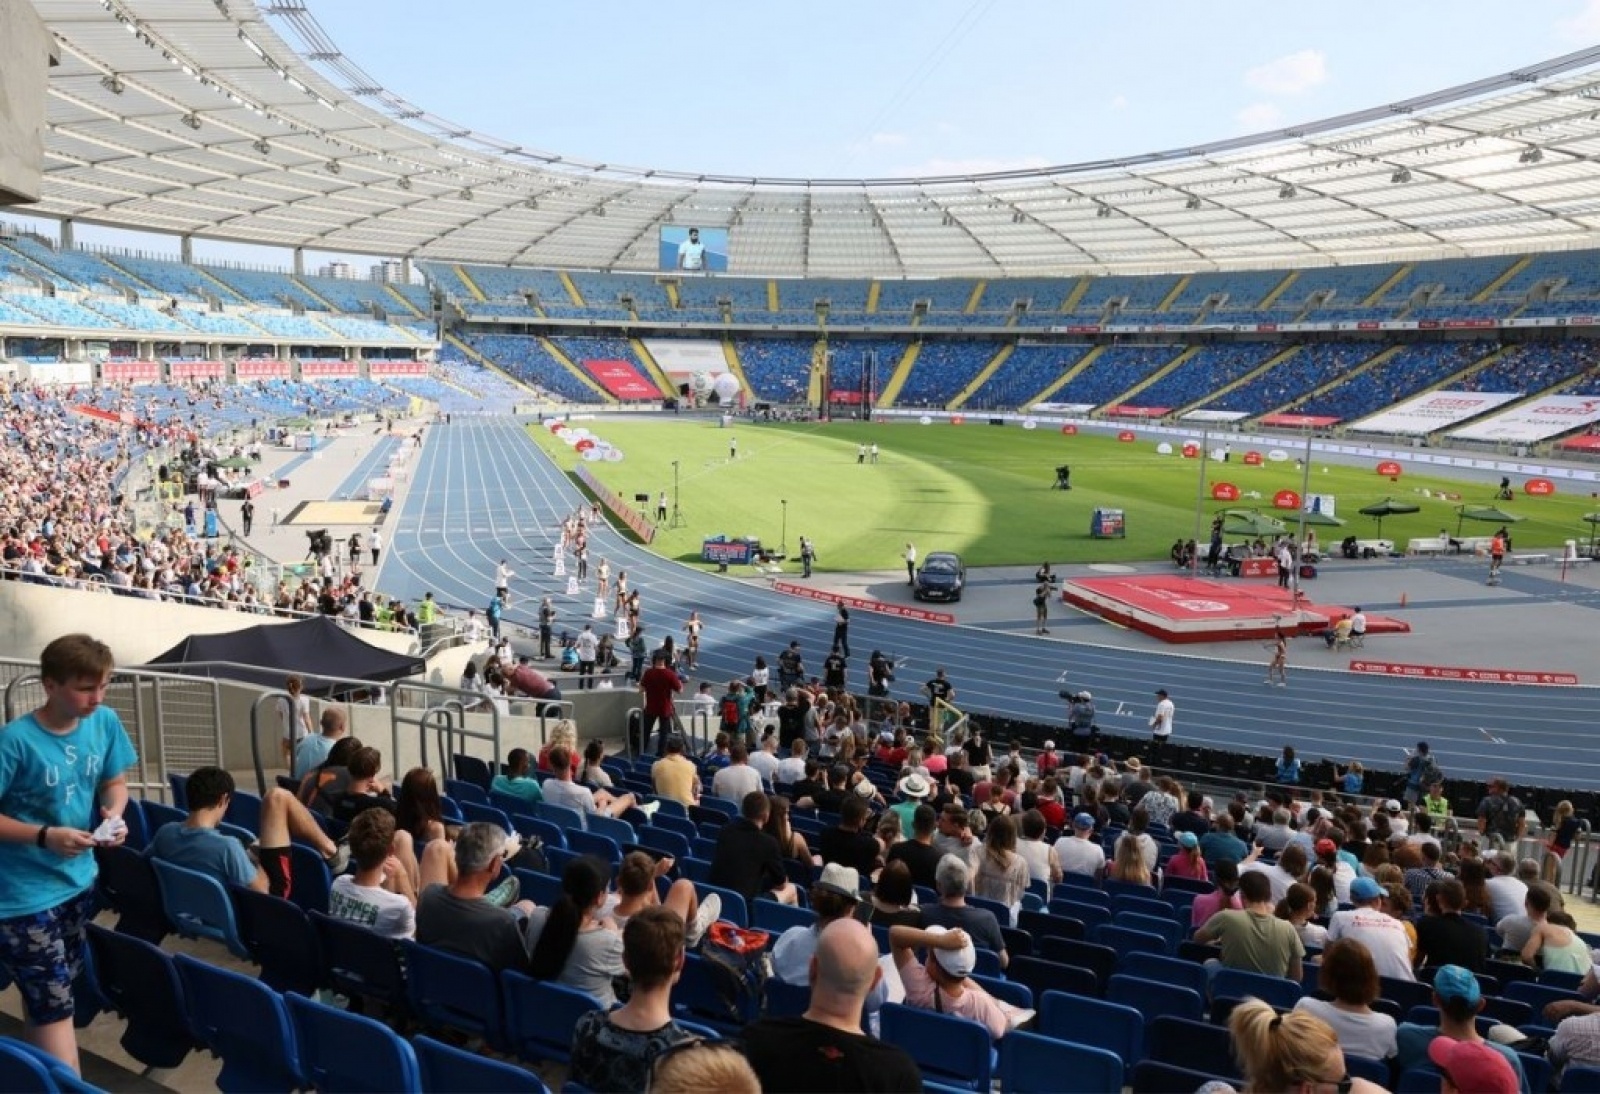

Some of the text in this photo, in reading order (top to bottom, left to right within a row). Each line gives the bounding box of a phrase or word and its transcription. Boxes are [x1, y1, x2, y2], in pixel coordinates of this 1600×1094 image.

[65, 745, 77, 765] S
[86, 754, 99, 776] R
[46, 765, 59, 787] U
[65, 783, 75, 805] F
